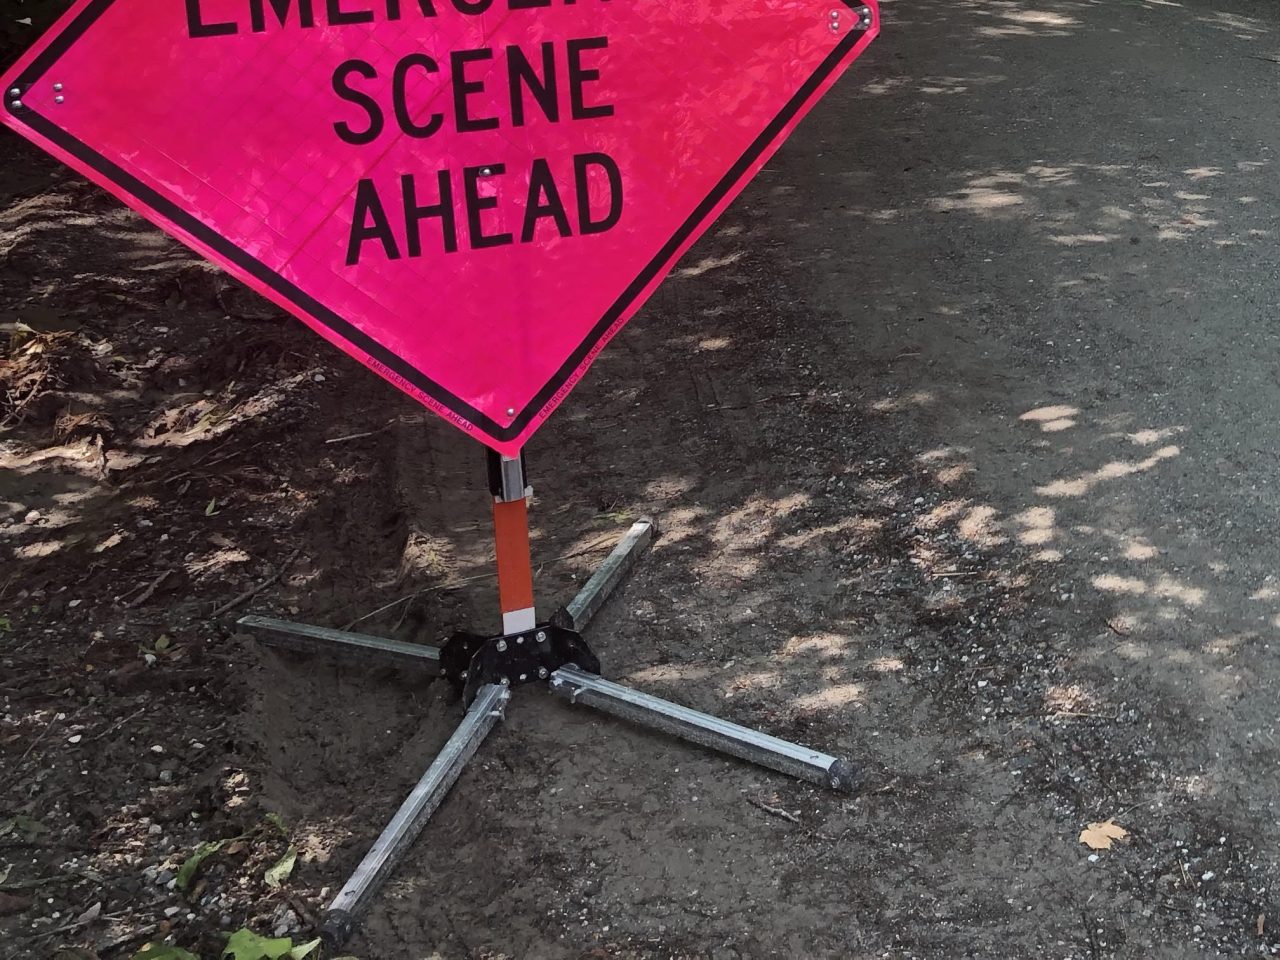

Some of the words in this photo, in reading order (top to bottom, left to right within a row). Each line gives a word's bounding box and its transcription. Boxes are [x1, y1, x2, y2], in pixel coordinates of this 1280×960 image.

[332, 37, 614, 145] SCENE
[346, 153, 624, 267] AHEAD
[366, 357, 416, 393] EMERGENCY
[417, 391, 445, 414] SCENE
[446, 410, 474, 432] AHEAD
[538, 371, 580, 420] EMERGENCY
[580, 345, 602, 372] SCENE
[602, 318, 625, 343] AHEAD
